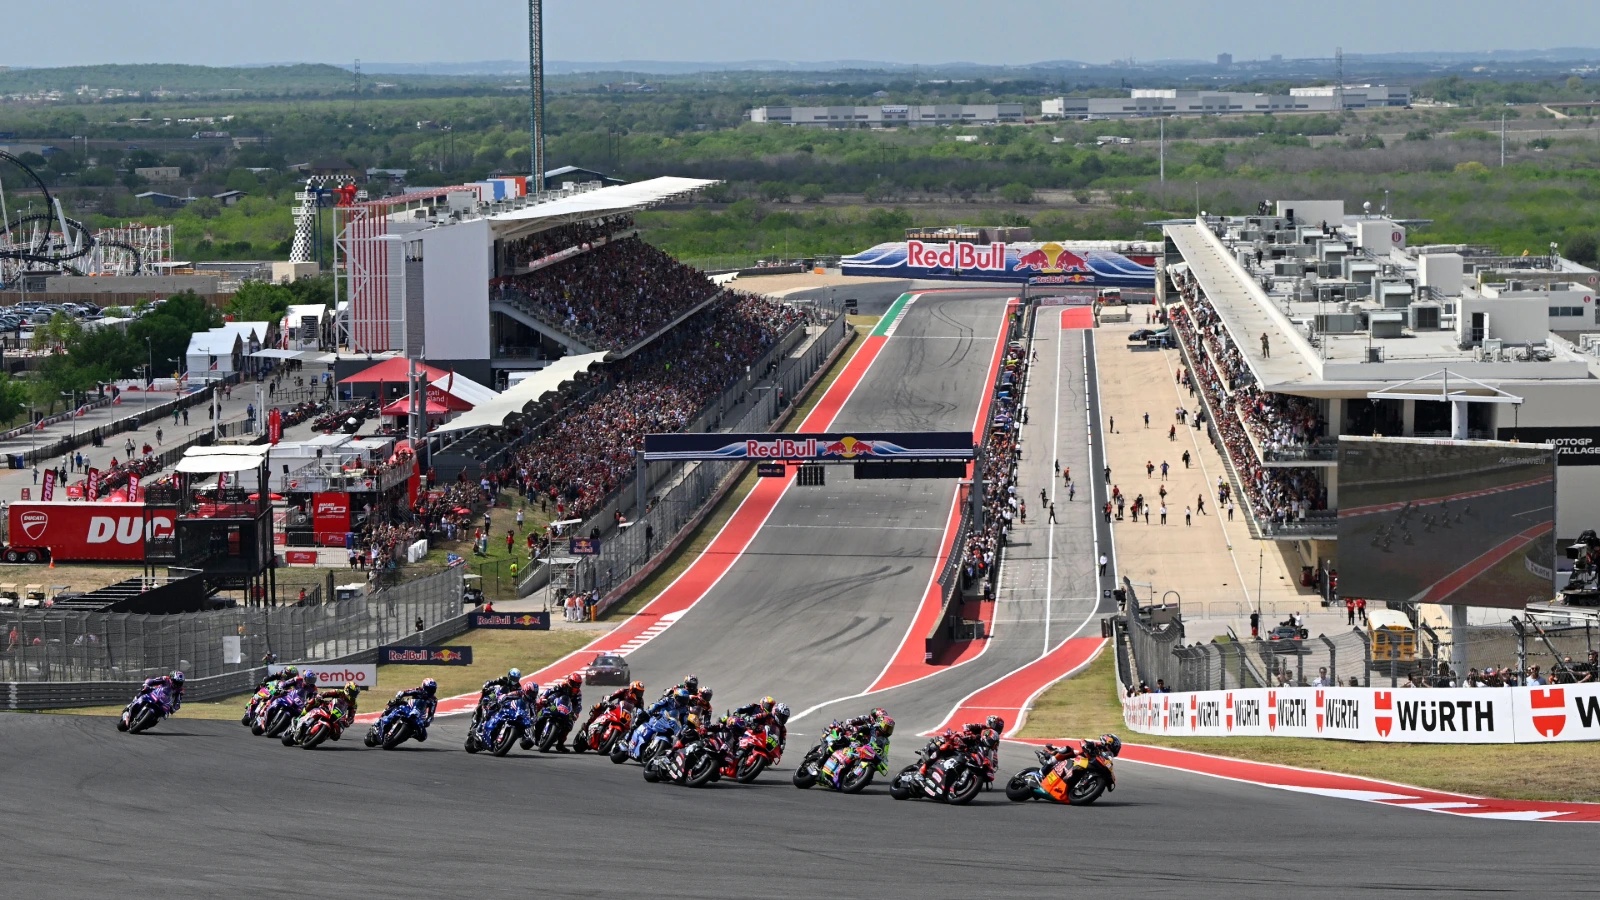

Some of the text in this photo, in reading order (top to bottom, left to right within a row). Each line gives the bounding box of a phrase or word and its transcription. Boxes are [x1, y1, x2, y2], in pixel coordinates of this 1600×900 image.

[907, 240, 1006, 271] Red Bull
[1036, 275, 1064, 283] Red Bull
[746, 438, 817, 457] Red Bull
[477, 616, 511, 625] Red Bull
[389, 650, 428, 661] Red Bull
[1196, 701, 1220, 727] WÜRTH
[1234, 700, 1260, 726] WÜRTH
[1277, 699, 1306, 727] WÜRTH
[1326, 698, 1358, 729] WÜRTH
[1397, 700, 1494, 732] WÜRTH
